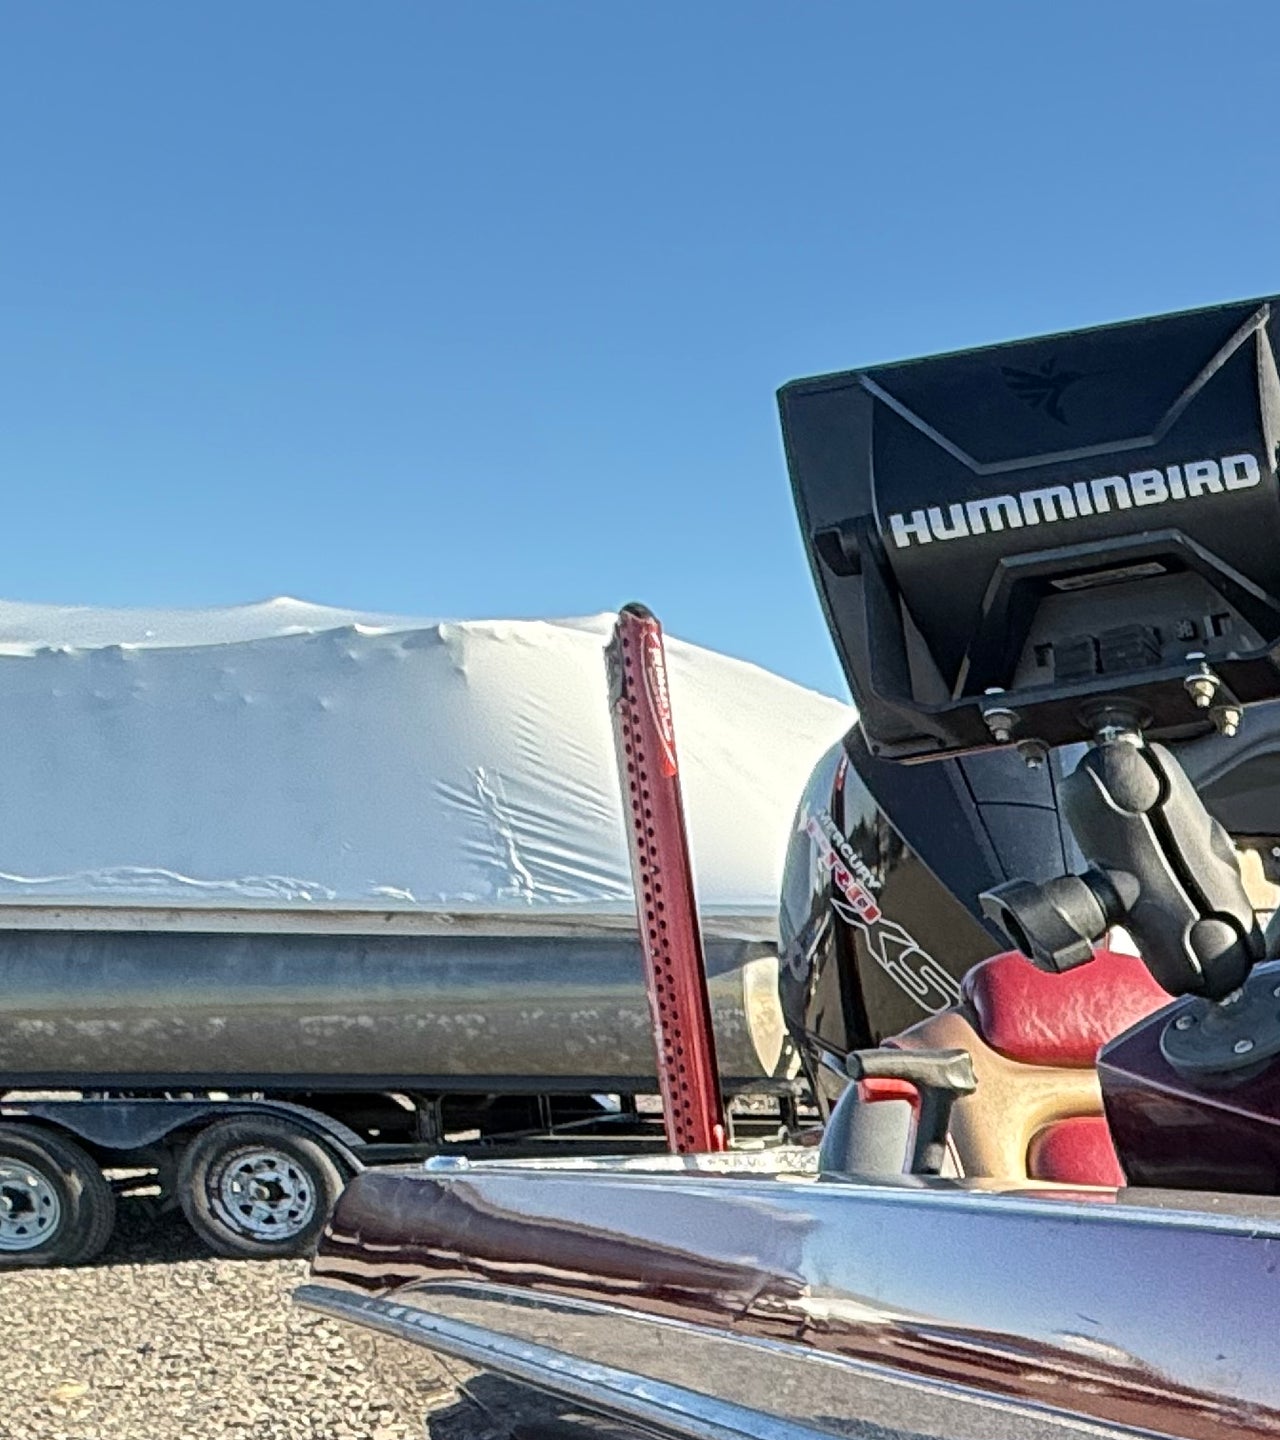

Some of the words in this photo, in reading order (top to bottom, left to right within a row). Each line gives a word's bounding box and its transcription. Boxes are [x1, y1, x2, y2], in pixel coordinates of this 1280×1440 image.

[889, 453, 1260, 548] HUMMINBIRD
[816, 808, 882, 889] MERCURY
[830, 897, 962, 1014] XS
